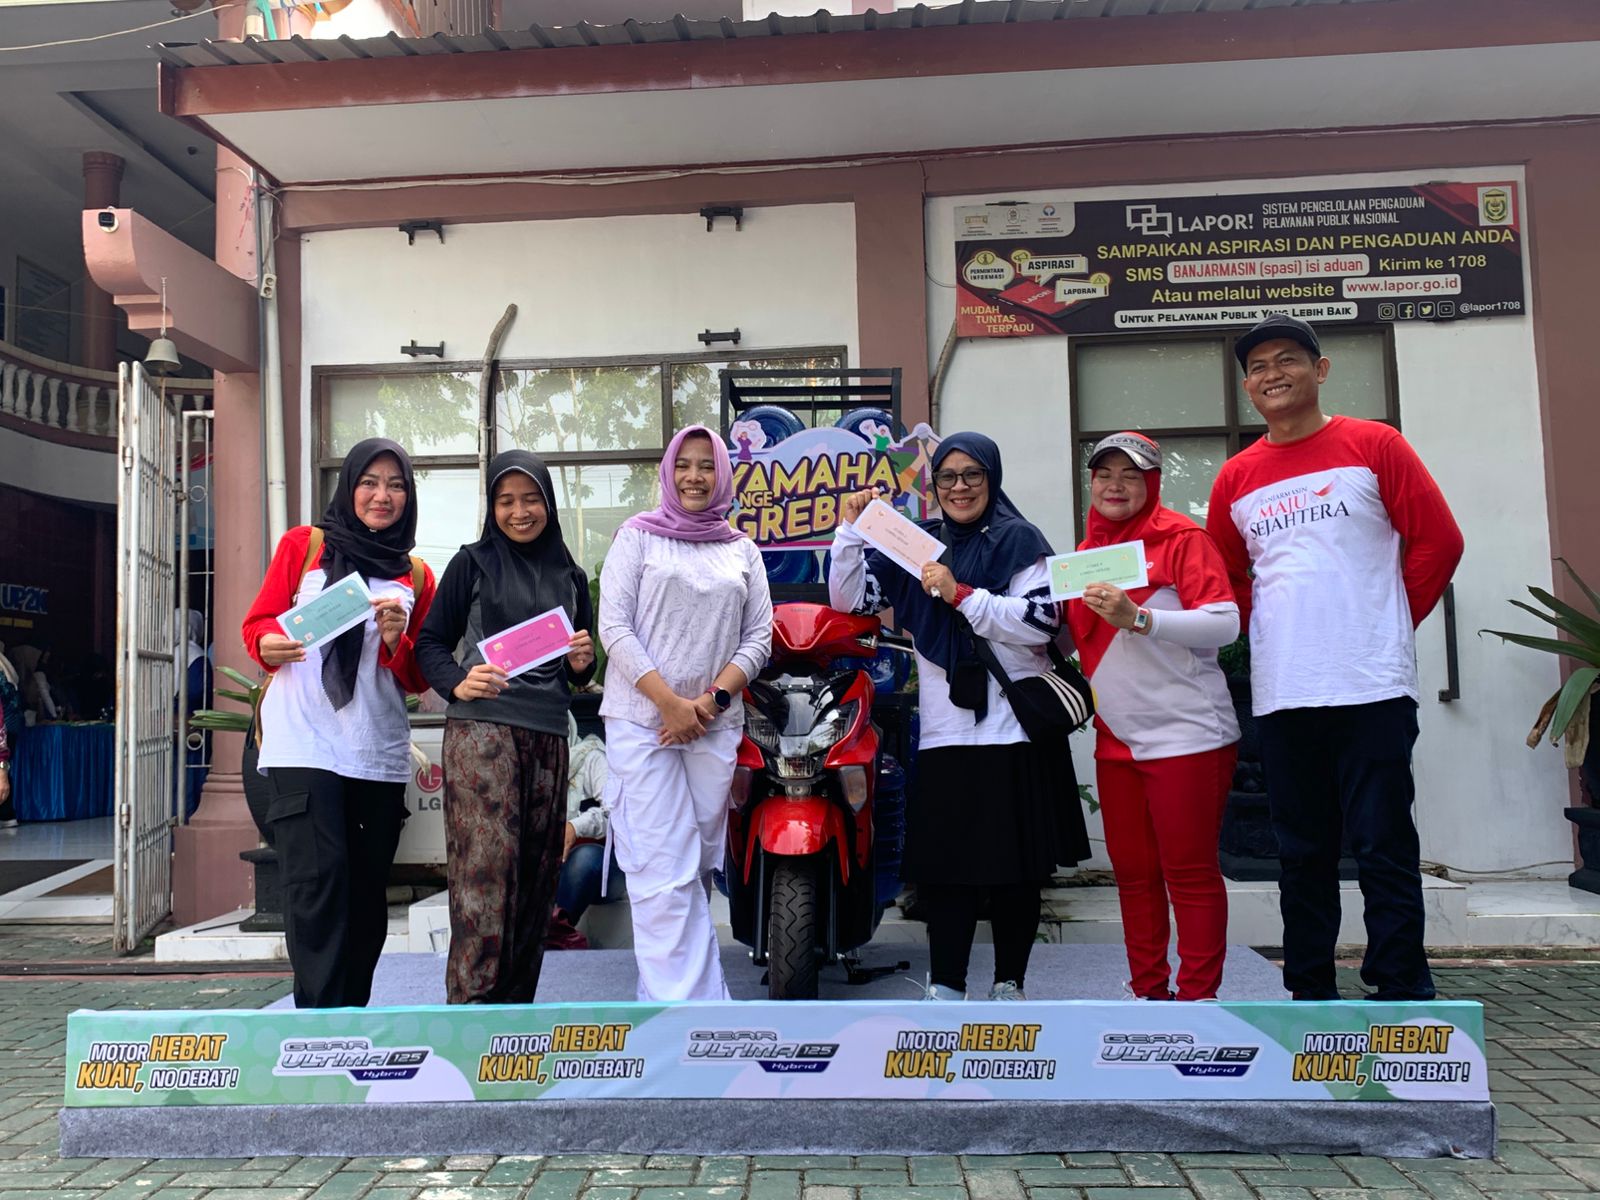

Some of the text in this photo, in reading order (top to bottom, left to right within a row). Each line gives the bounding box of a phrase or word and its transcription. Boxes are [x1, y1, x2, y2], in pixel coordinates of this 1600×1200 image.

[1262, 197, 1425, 215] SISTEM PENGELOLAAN PENGADUAN
[1178, 213, 1254, 232] LAPOR!
[1262, 212, 1400, 229] PELAYANAN PUBLIK NASIONAL
[1097, 229, 1514, 259] SAMPAIKAN ASPIRASI DAN PENGADUAN ANDA
[970, 267, 1005, 275] PERMINTAAN
[1028, 259, 1075, 270] ASPIRASI
[1126, 254, 1487, 282] SMS BANJARMASIN (spasi) isi aduan Kirim ke 1708
[1064, 287, 1097, 295] LAPORAN
[1151, 277, 1458, 303] Atau melalui website www.lapor.go.id
[960, 306, 999, 315] MUDAH
[1459, 301, 1520, 314] @lapor1708
[975, 314, 1016, 323] TUNTAS
[987, 323, 1034, 333] TERPADU
[731, 454, 898, 499] YAMAHA
[739, 491, 774, 508] NGE
[1260, 493, 1307, 518] MAJU
[728, 493, 893, 542] GREB
[1250, 500, 1350, 540] SEJAHTERA
[0, 583, 49, 615] UP2K
[418, 797, 441, 811] LG
[491, 1025, 631, 1055] MOTOR HEBAT
[690, 1031, 777, 1041] GEAR
[896, 1024, 1041, 1051] MOTOR HEBAT
[1103, 1033, 1194, 1044] GEAR
[1304, 1025, 1454, 1053] MOTOR HEBAT
[90, 1035, 226, 1061] MOTOR HEBAT
[284, 1041, 368, 1051] GEAR
[687, 1042, 834, 1058] ULTIMA 125
[1101, 1045, 1253, 1062] ULTIMA 125
[282, 1051, 426, 1067] ULTIMA 125
[771, 1061, 816, 1071] Hybrid
[884, 1051, 955, 1083] KUAT,
[963, 1059, 992, 1079] NO
[77, 1061, 144, 1092] KUAT,
[151, 1069, 180, 1088] NO
[363, 1069, 408, 1079] Hybrid
[478, 1055, 547, 1084] KUAT,
[554, 1060, 582, 1079] NO
[1188, 1065, 1236, 1075] Hybrid
[1292, 1053, 1367, 1086] KUAT,
[1373, 1062, 1401, 1082] NO
